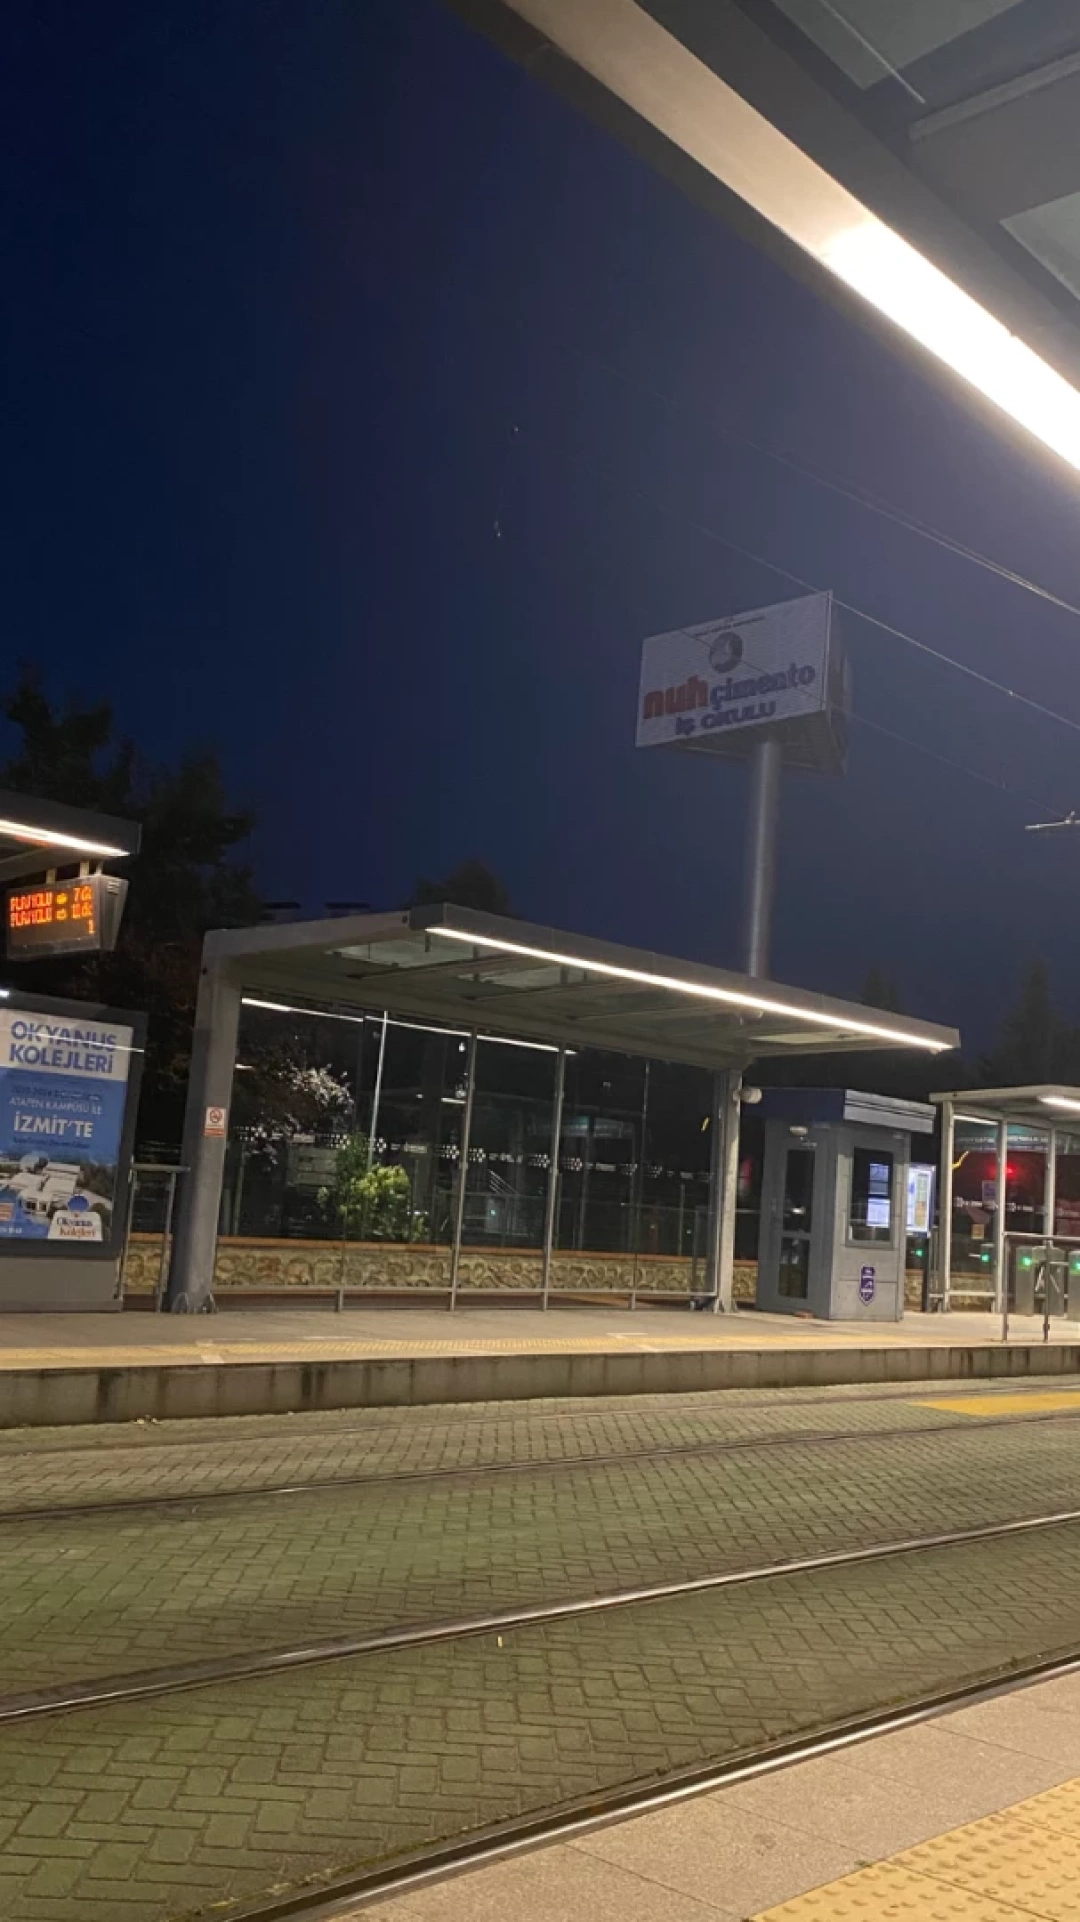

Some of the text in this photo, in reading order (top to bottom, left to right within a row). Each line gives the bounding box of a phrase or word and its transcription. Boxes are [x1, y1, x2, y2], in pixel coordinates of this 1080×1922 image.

[643, 674, 709, 719] nuh
[11, 1020, 117, 1052] OKYANUS
[9, 1043, 113, 1073] KOLEJLERİ
